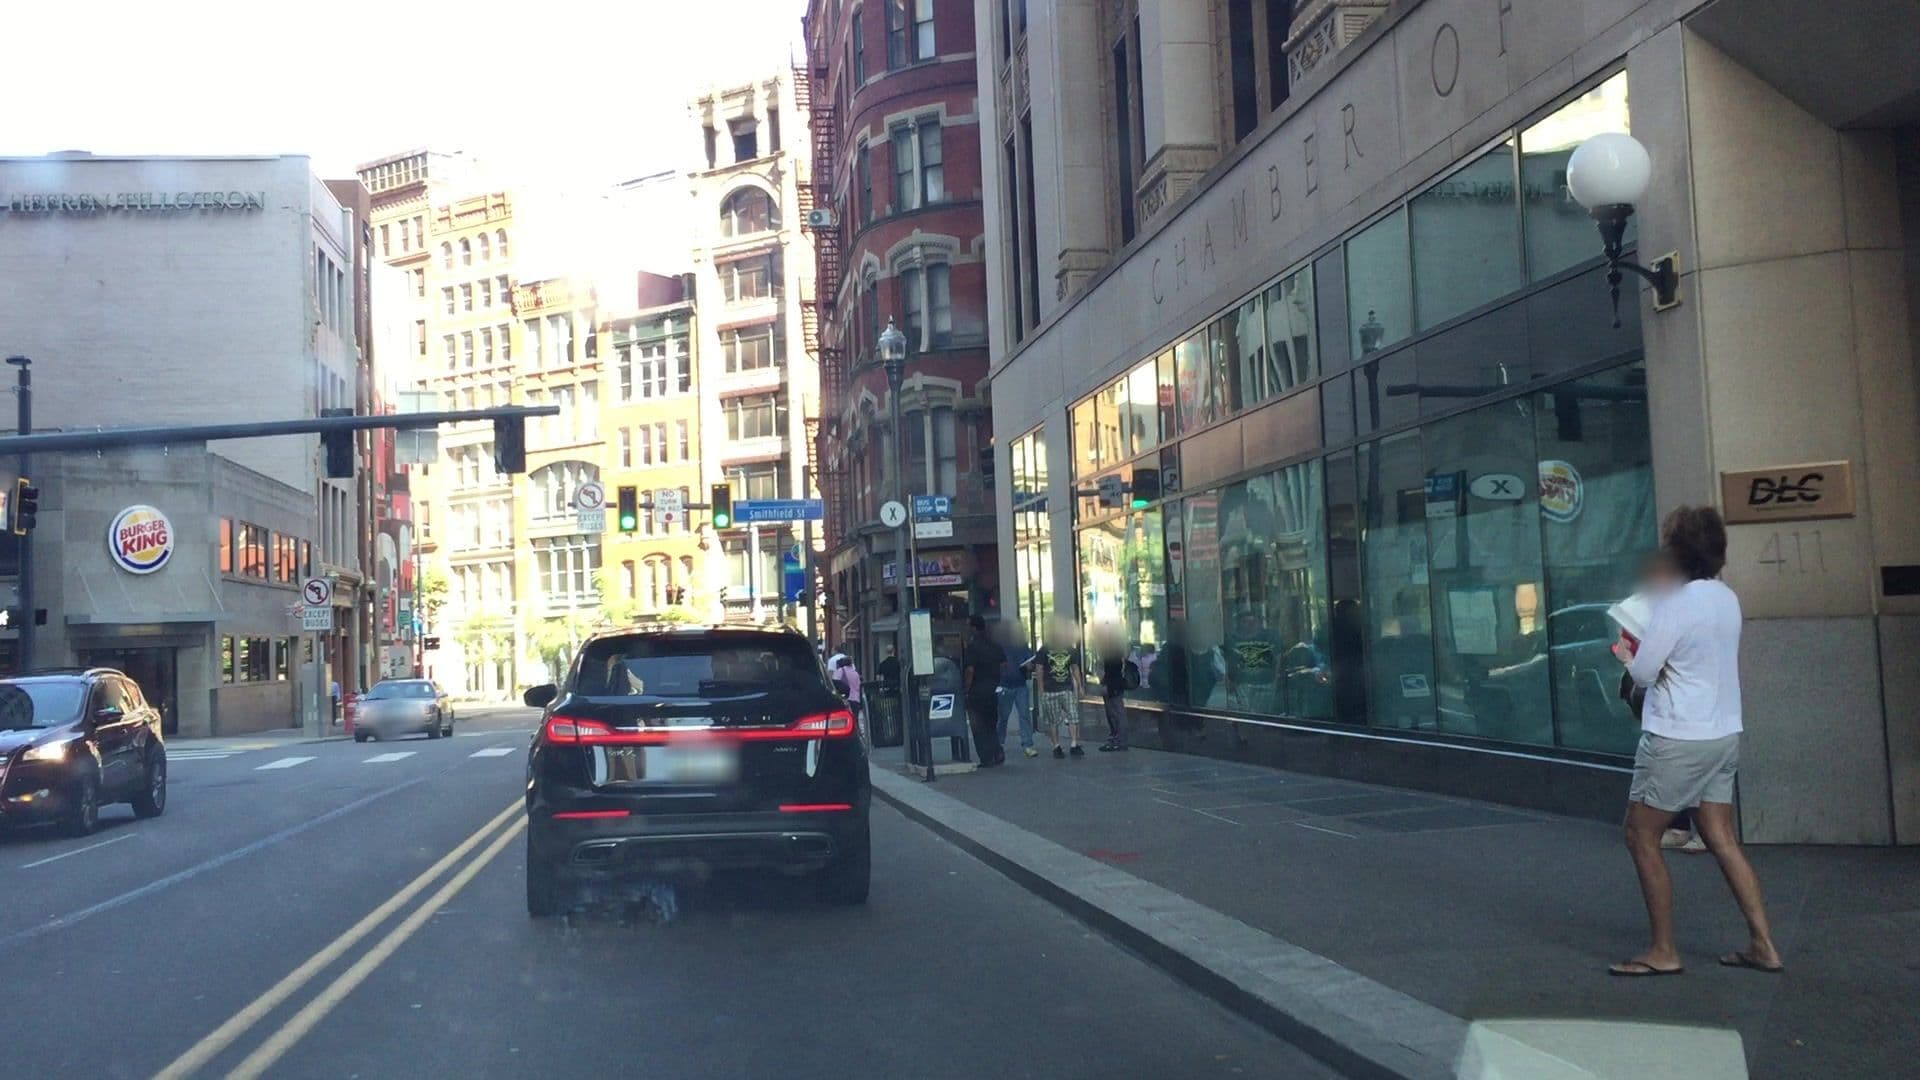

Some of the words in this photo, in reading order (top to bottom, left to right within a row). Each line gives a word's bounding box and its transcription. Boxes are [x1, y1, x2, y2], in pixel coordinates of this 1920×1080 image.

[1151, 103, 1364, 305] CHAMBER
[662, 490, 675, 498] NO
[749, 508, 793, 520] Smithfield
[796, 509, 805, 518] St
[889, 507, 897, 521] X
[916, 506, 933, 514] STOP
[119, 519, 166, 541] BURGER
[121, 530, 168, 556] KING
[1756, 529, 1828, 577] 411
[304, 609, 329, 618] EXCEPT
[305, 618, 329, 627] BUSES
